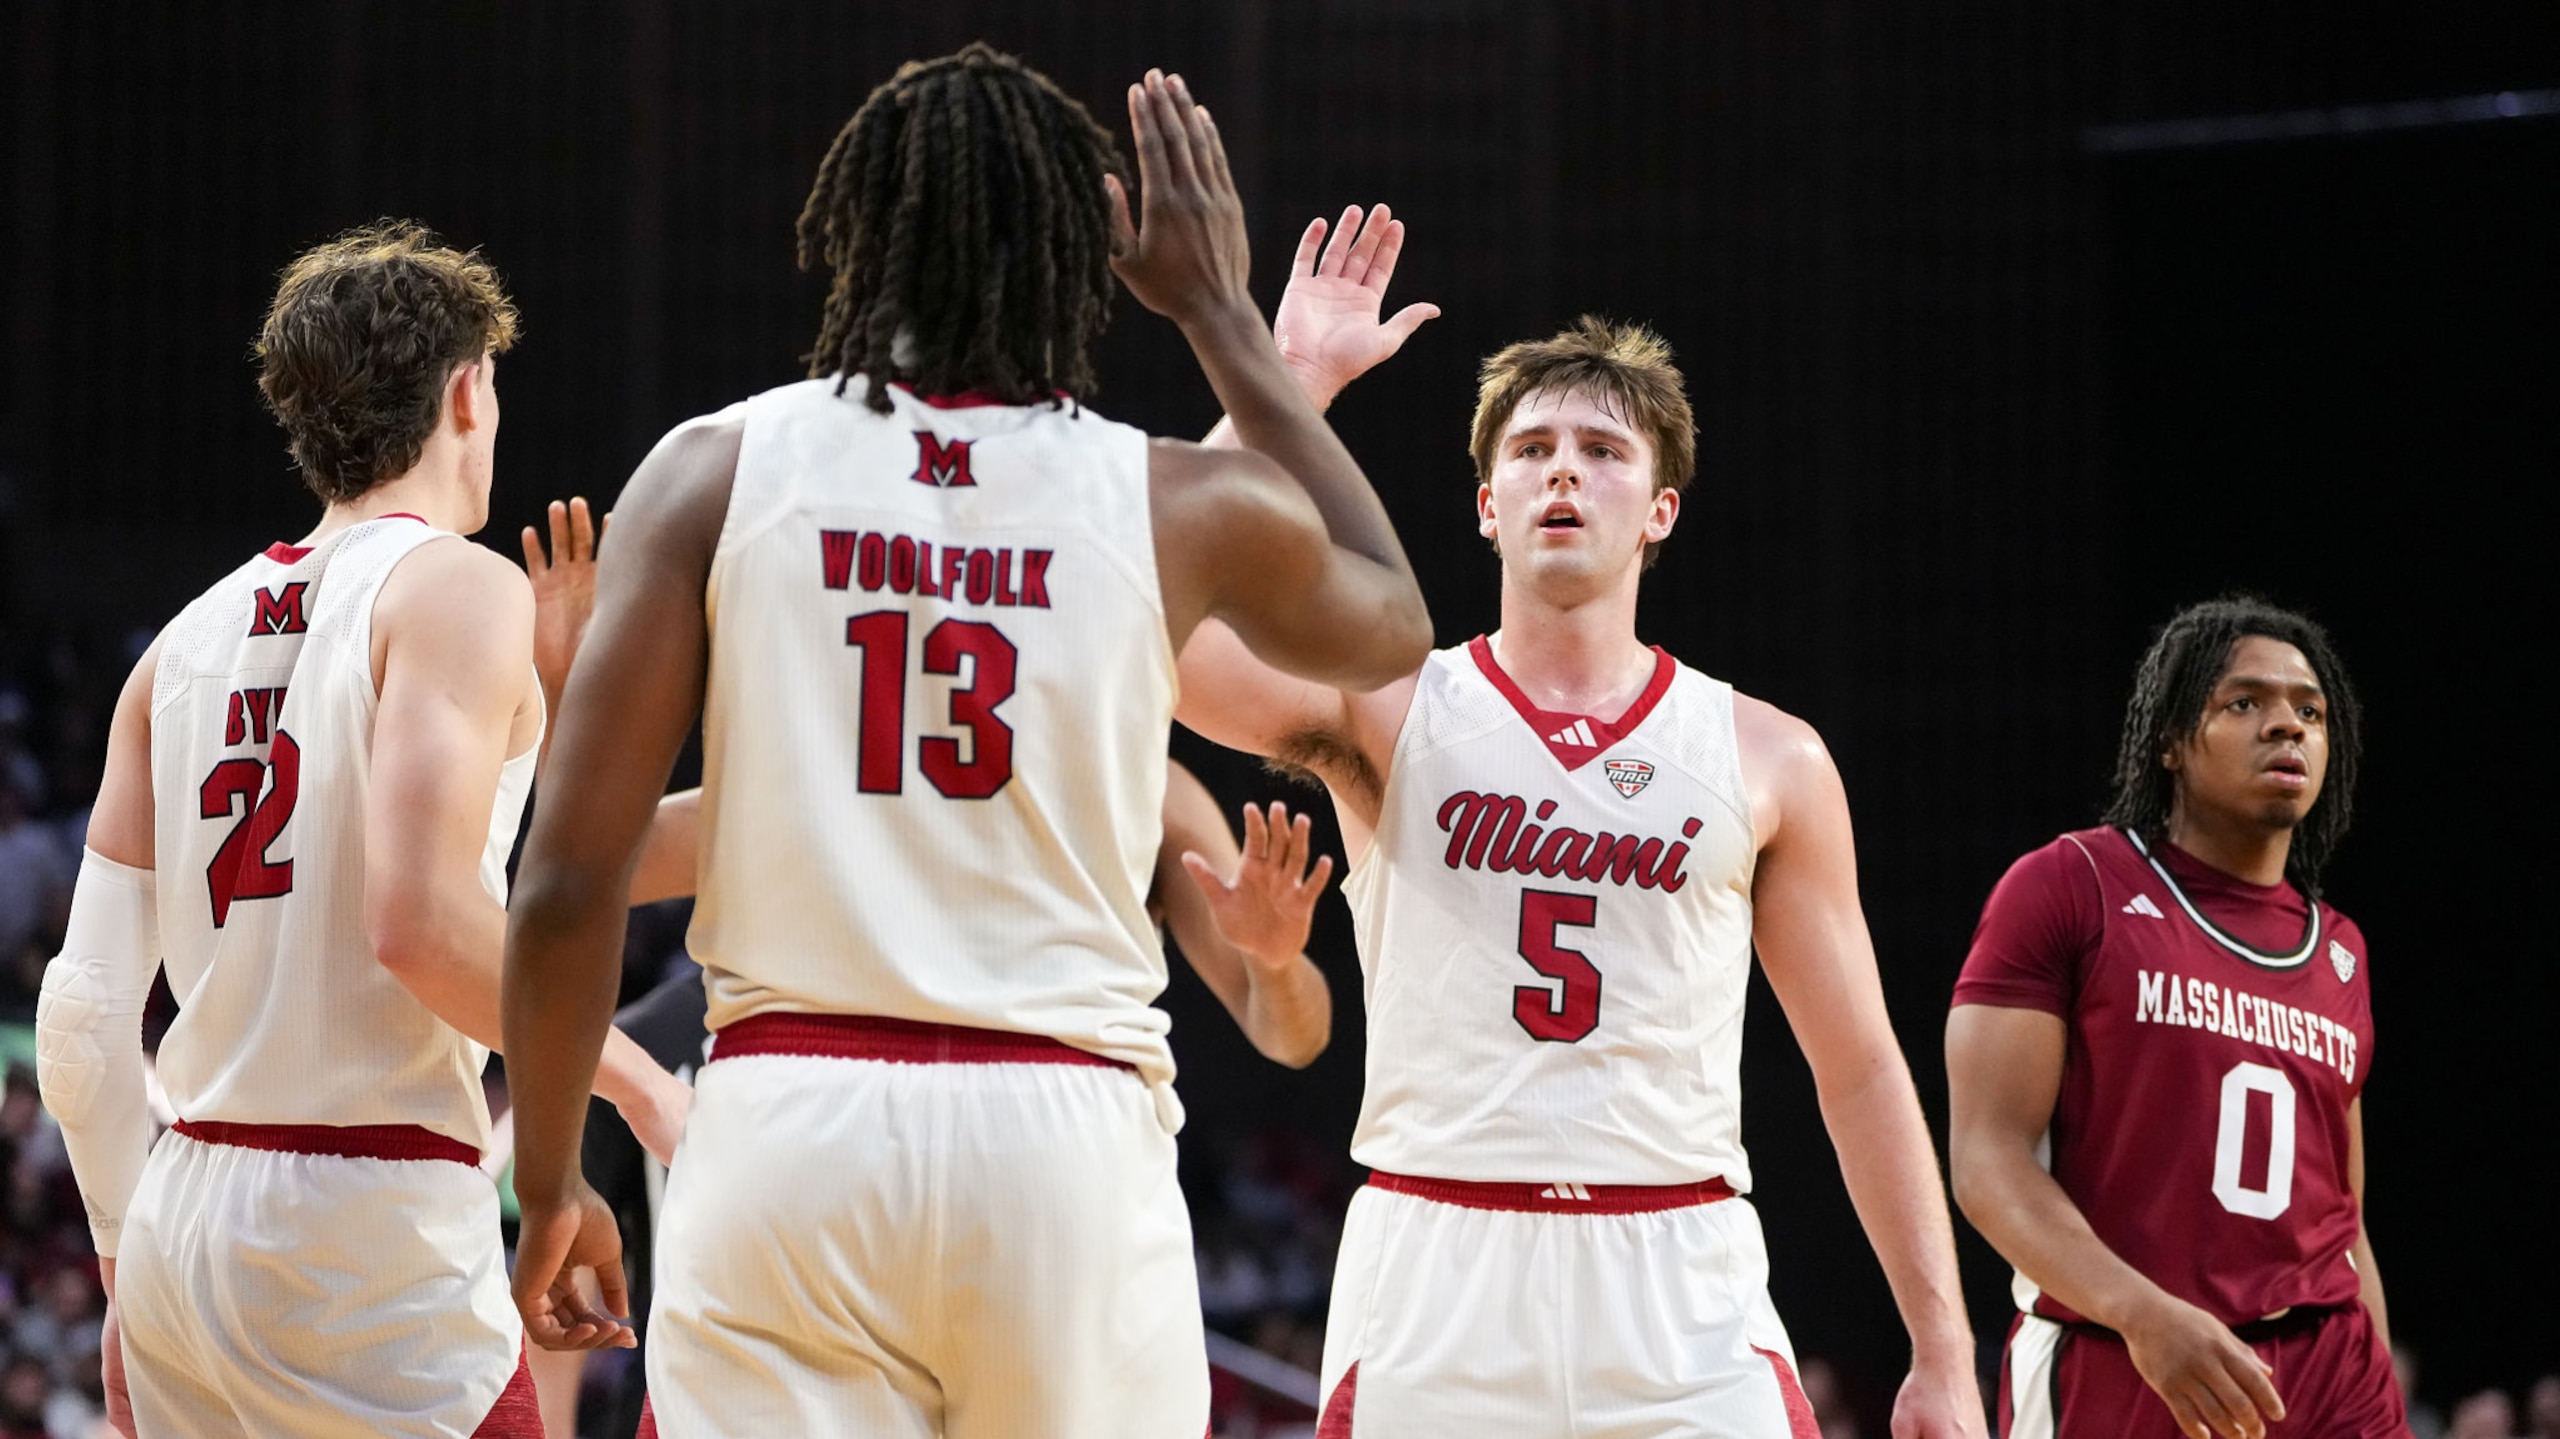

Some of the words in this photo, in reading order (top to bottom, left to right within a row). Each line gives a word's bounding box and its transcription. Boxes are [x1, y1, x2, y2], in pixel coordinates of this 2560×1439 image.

[909, 430, 978, 487] M
[248, 581, 310, 637] M
[820, 529, 1053, 609] WOOLFOLK
[846, 610, 1017, 799] 13
[1437, 791, 1703, 893] Miami
[1513, 887, 1602, 1043] 5
[2136, 970, 2357, 1084] MASSACHUSETTS
[2212, 1061, 2296, 1221] 0
